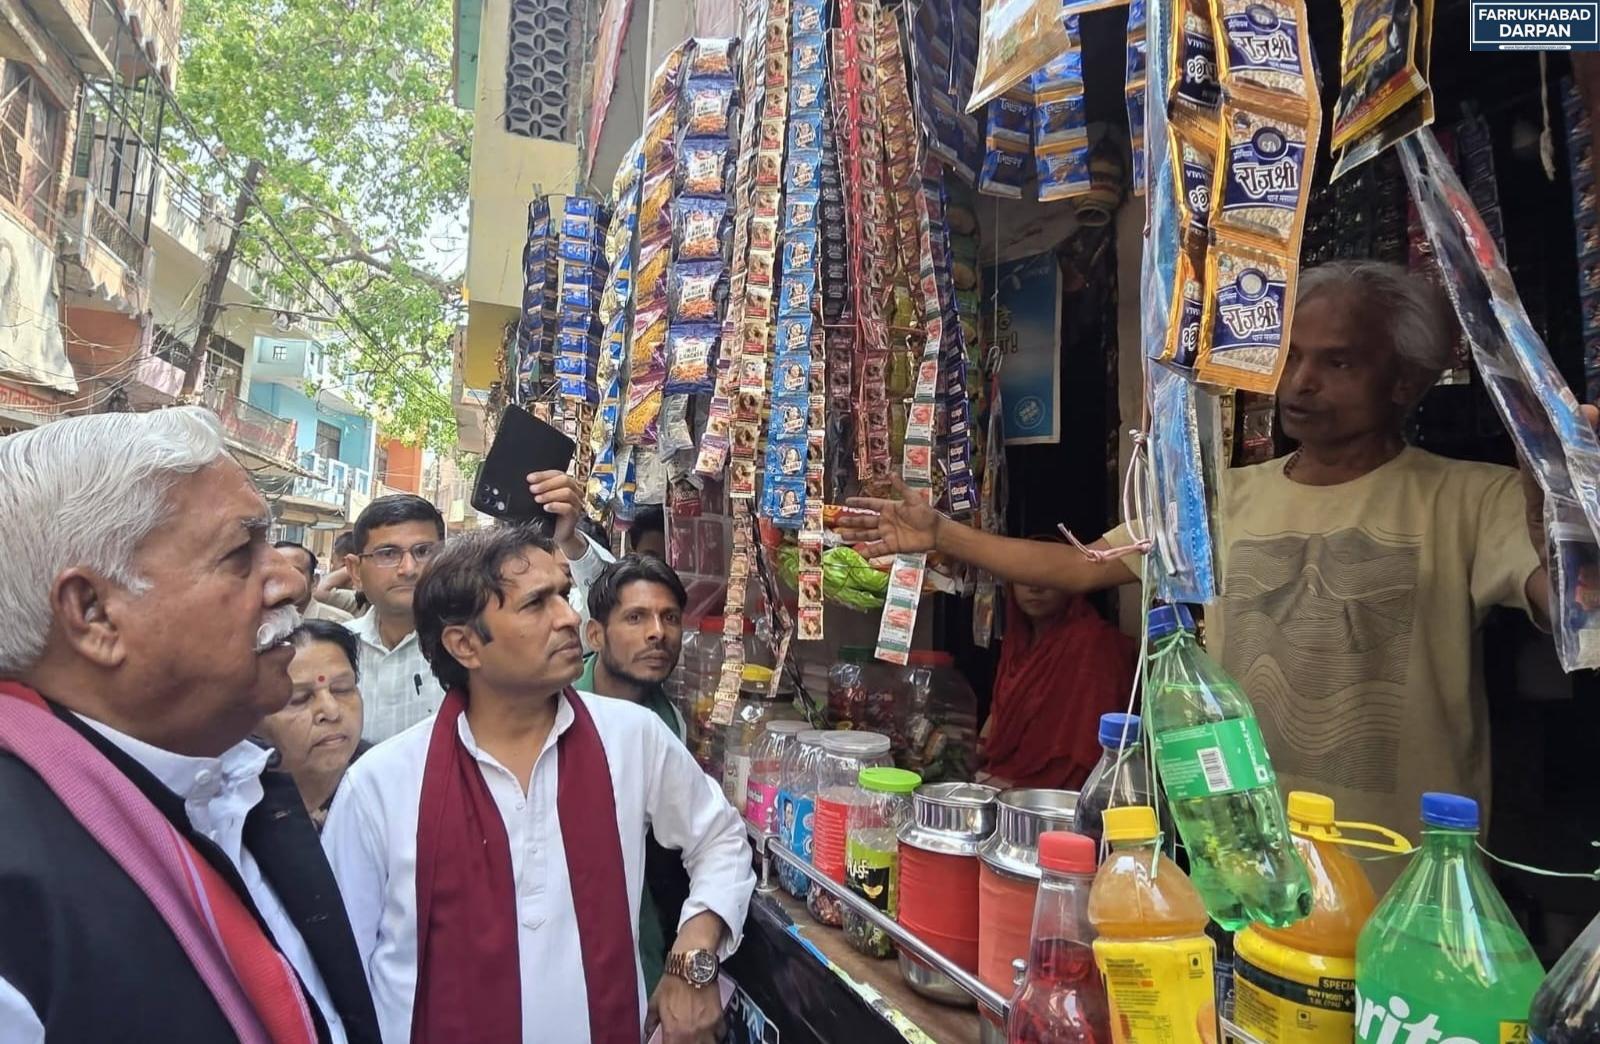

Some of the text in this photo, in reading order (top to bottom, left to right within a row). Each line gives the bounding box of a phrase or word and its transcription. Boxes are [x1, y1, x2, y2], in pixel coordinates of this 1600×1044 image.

[1233, 158, 1299, 199] राजश्री
[1220, 298, 1280, 338] राजश्री
[1323, 980, 1355, 990] SPECIA
